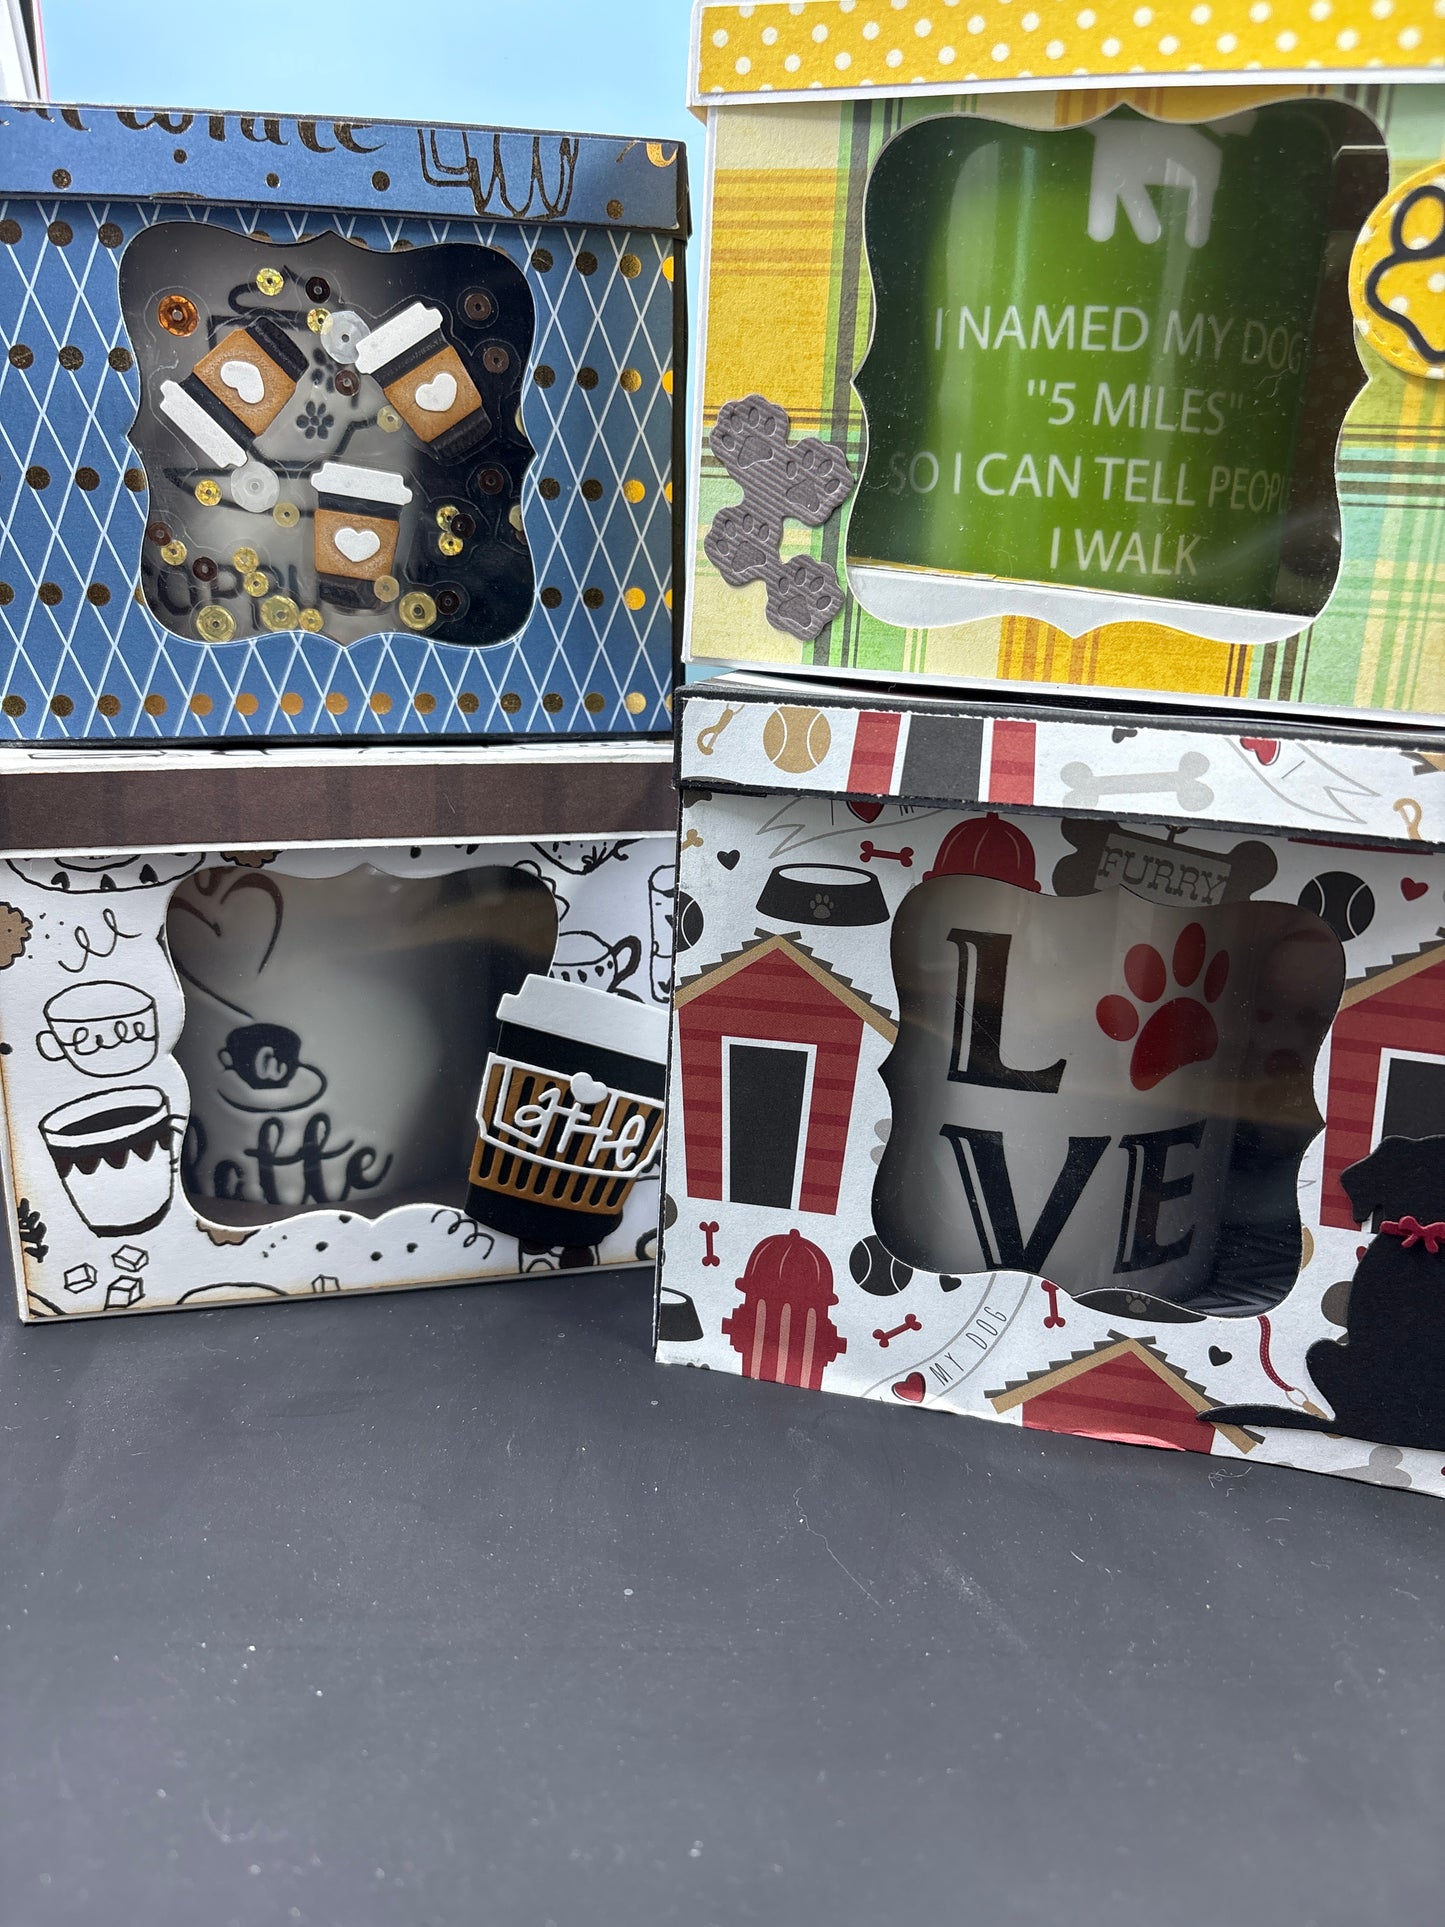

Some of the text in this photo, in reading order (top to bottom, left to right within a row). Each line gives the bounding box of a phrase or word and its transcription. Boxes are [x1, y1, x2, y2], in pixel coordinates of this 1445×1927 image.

[934, 303, 1303, 375] I NAMED MY DOG
[1026, 378, 1244, 436] "5 MILES"
[887, 450, 940, 496] SO
[953, 451, 963, 495] I
[975, 452, 1082, 499] CAN
[1093, 455, 1197, 507] TELL
[1049, 526, 1198, 577] I WALK
[1097, 846, 1230, 905] FURRY
[928, 1305, 1008, 1387] MY DOG
